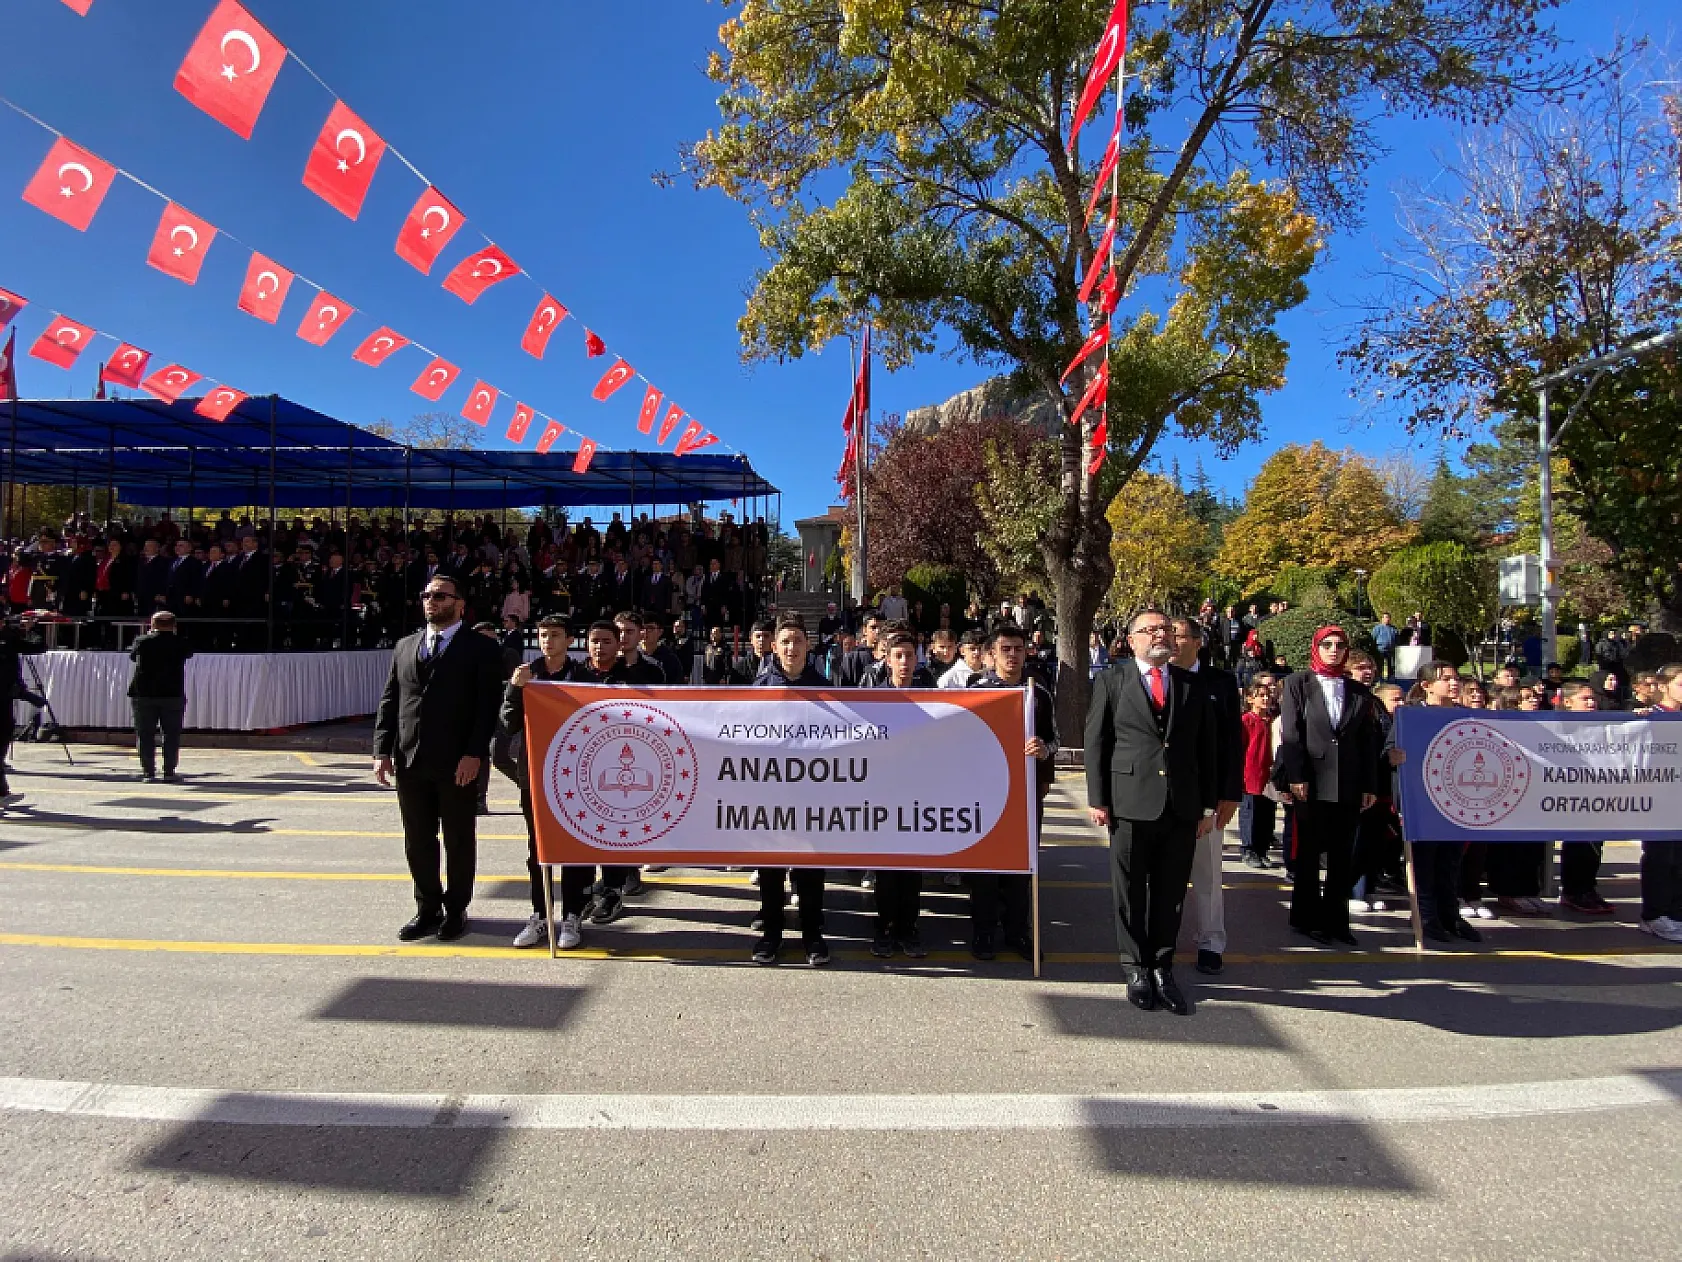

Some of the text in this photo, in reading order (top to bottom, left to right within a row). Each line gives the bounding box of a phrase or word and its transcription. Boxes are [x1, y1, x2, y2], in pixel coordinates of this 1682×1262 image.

[717, 722, 890, 741] AFYONKARAHİSAR
[717, 757, 869, 783] ANADOLU
[1543, 765, 1682, 785] KADINANA İMAM-
[1541, 796, 1653, 813] ORTAOKULU
[716, 799, 982, 834] İMAM HATİP LİSESİ
